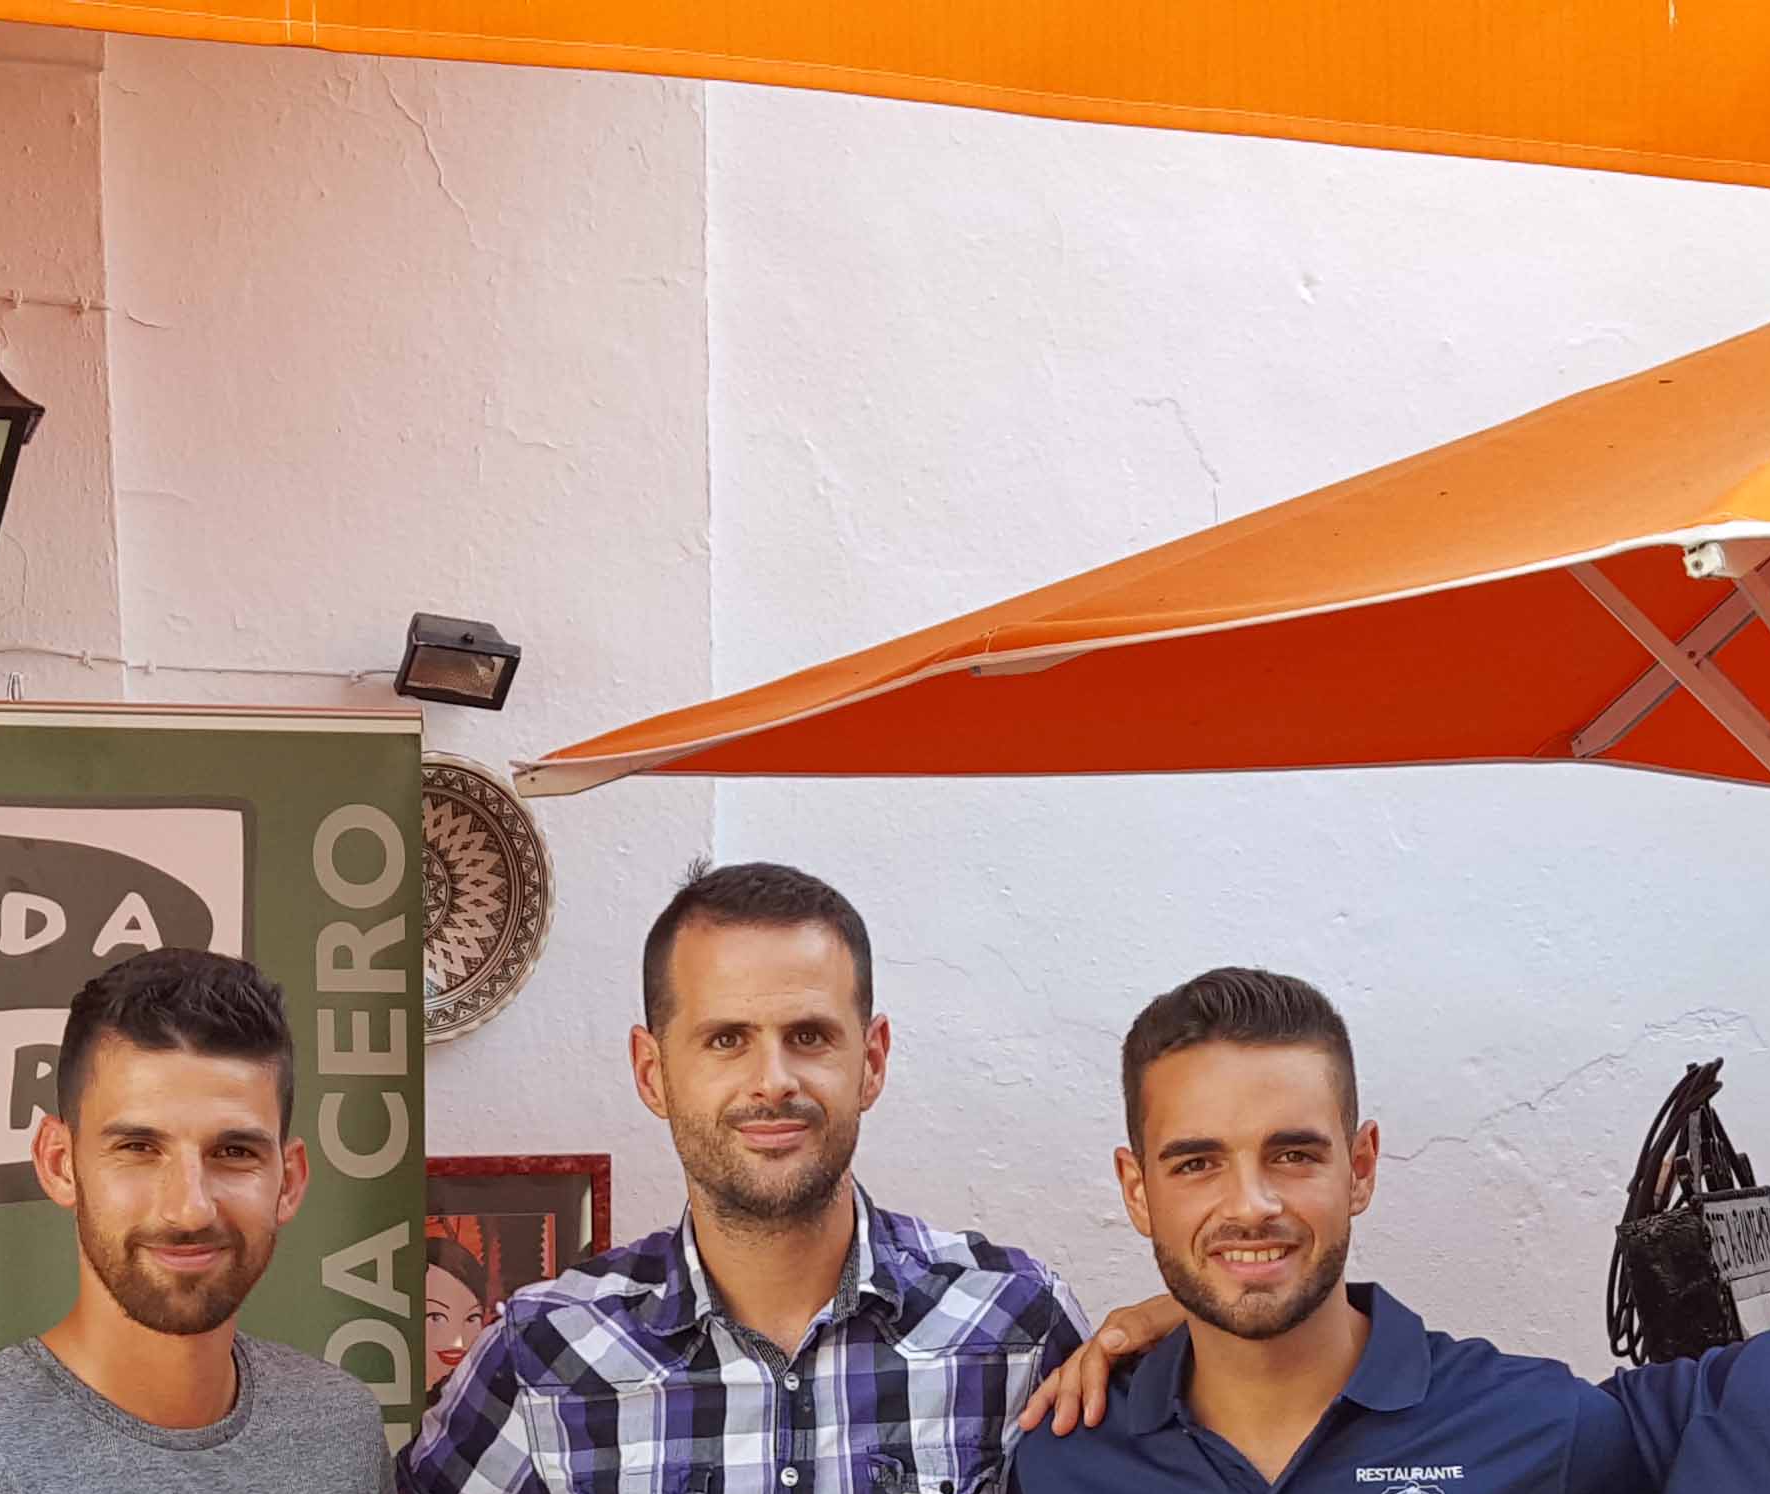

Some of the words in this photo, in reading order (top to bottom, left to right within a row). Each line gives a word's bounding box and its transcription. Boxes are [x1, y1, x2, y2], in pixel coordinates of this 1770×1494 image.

[311, 803, 409, 1180] CERO
[321, 1220, 412, 1458] DA
[1355, 1465, 1464, 1482] RESTAURANTE
